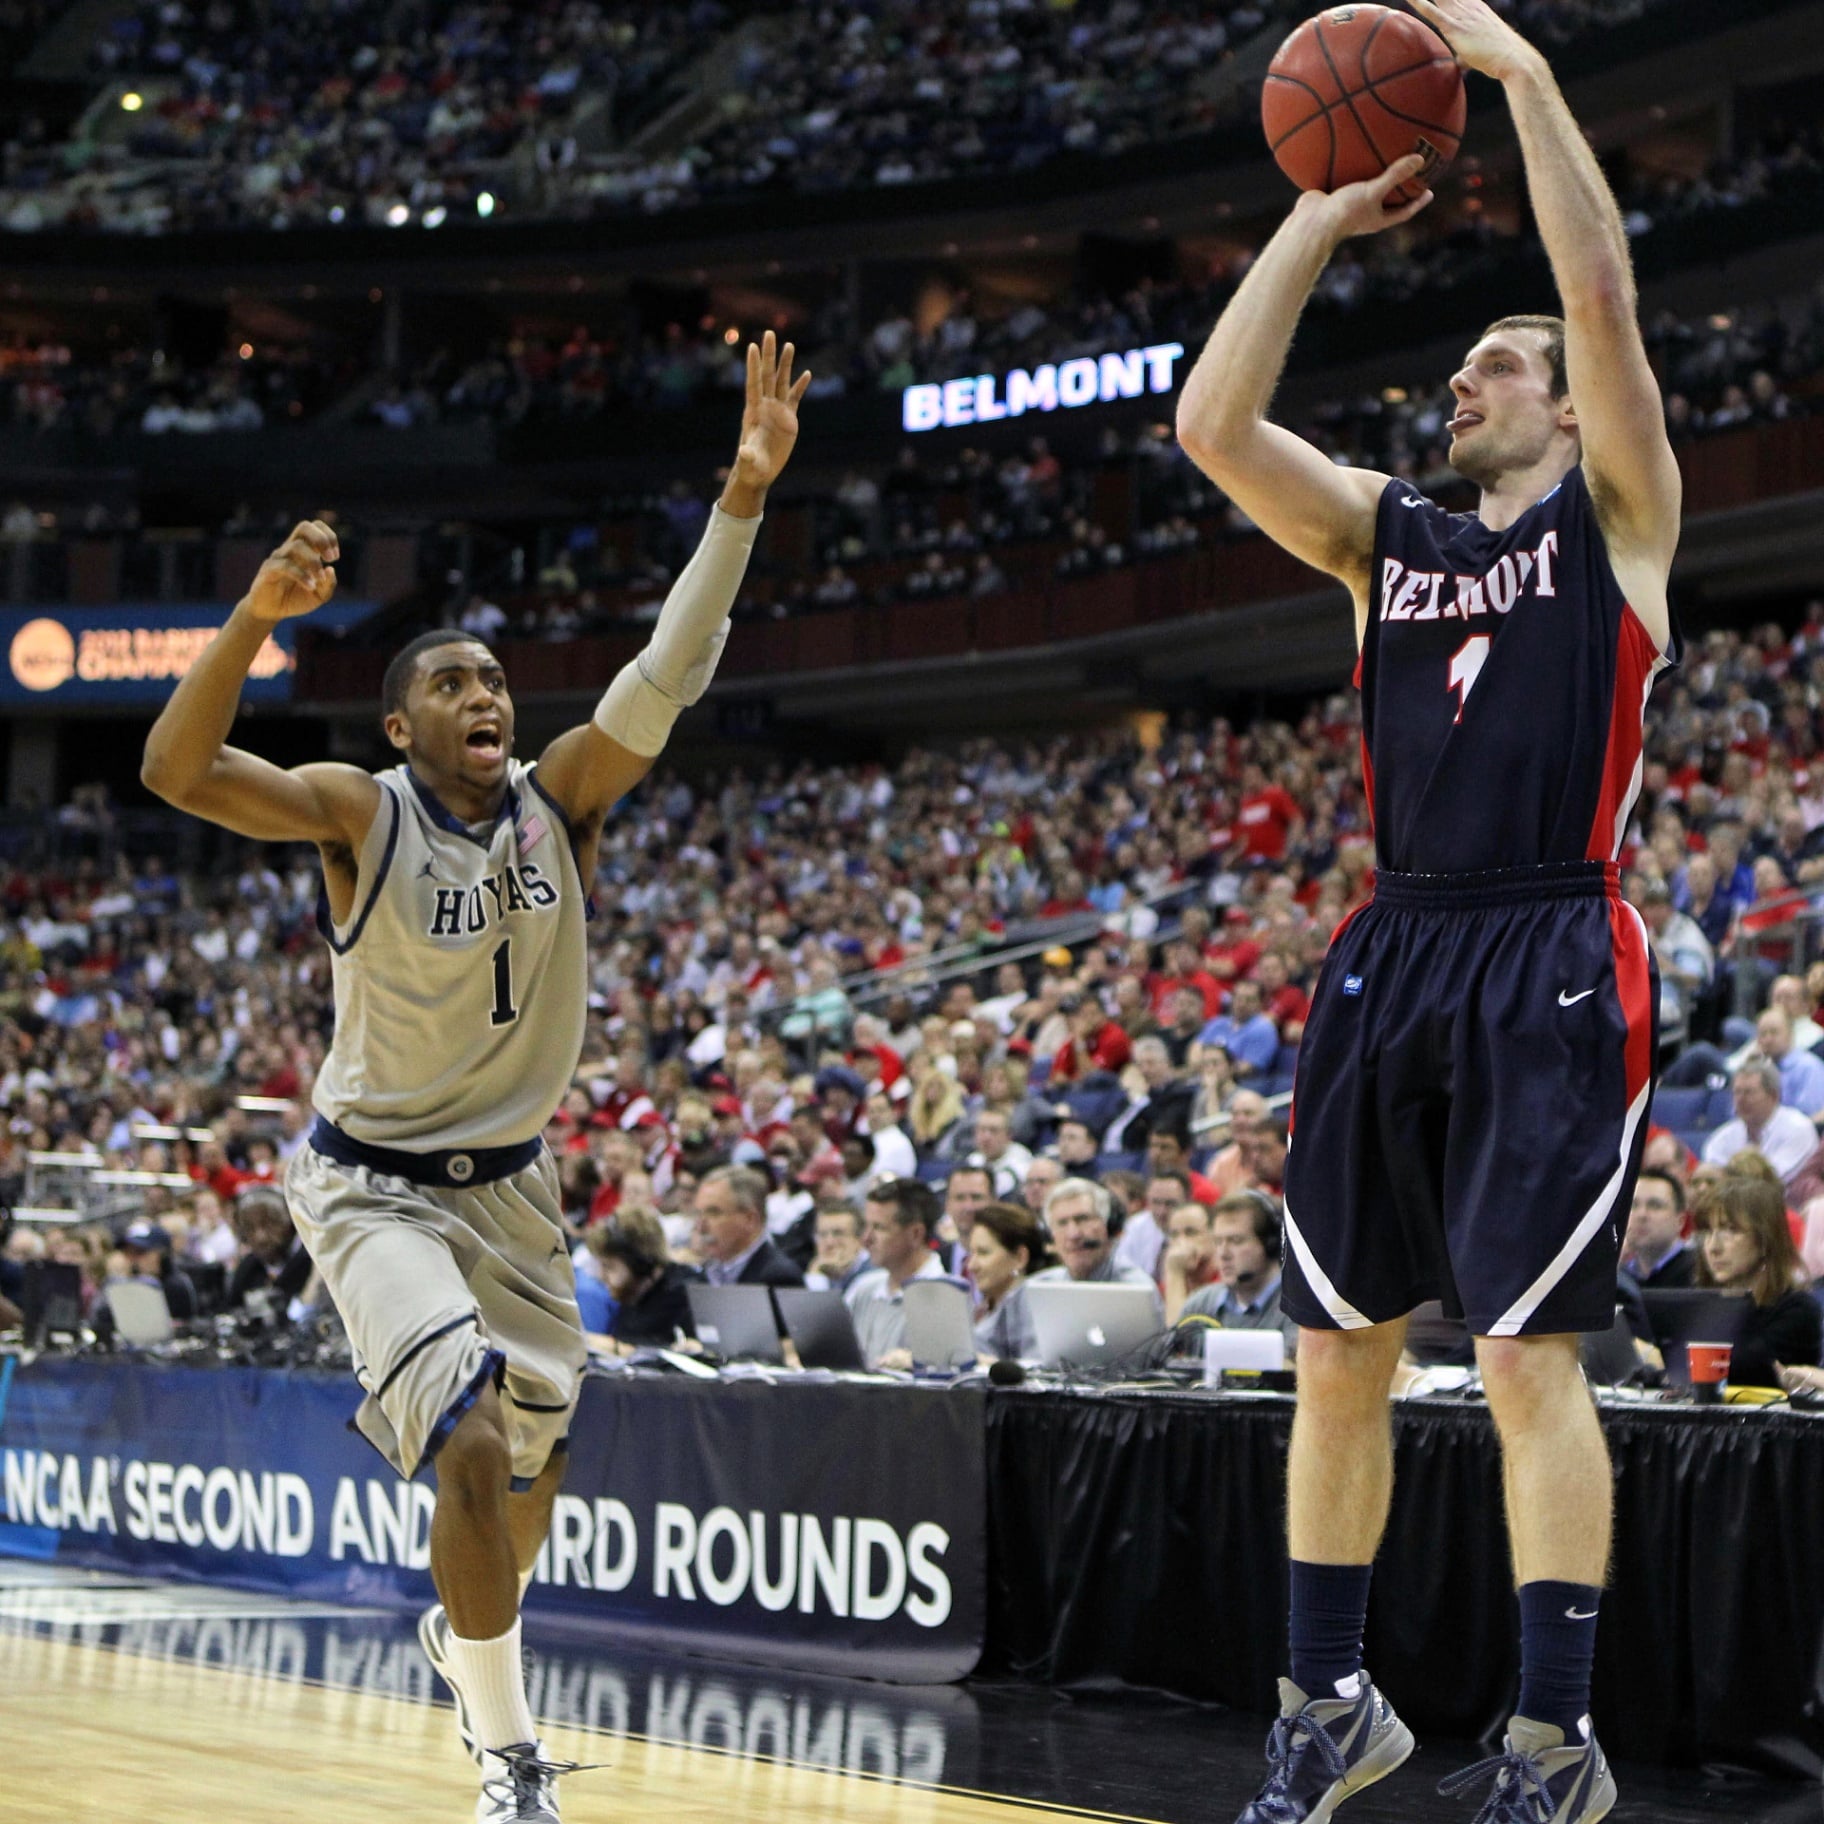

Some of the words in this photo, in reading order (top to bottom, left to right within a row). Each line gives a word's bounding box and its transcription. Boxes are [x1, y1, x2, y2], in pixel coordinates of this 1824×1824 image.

[902, 342, 1184, 432] BELMONT
[1447, 632, 1493, 725] 1
[429, 863, 559, 936] HOYAS
[489, 937, 519, 1027] 1
[124, 1460, 314, 1557] SECOND
[329, 1476, 438, 1571] AND
[653, 1502, 952, 1628] ROUNDS
